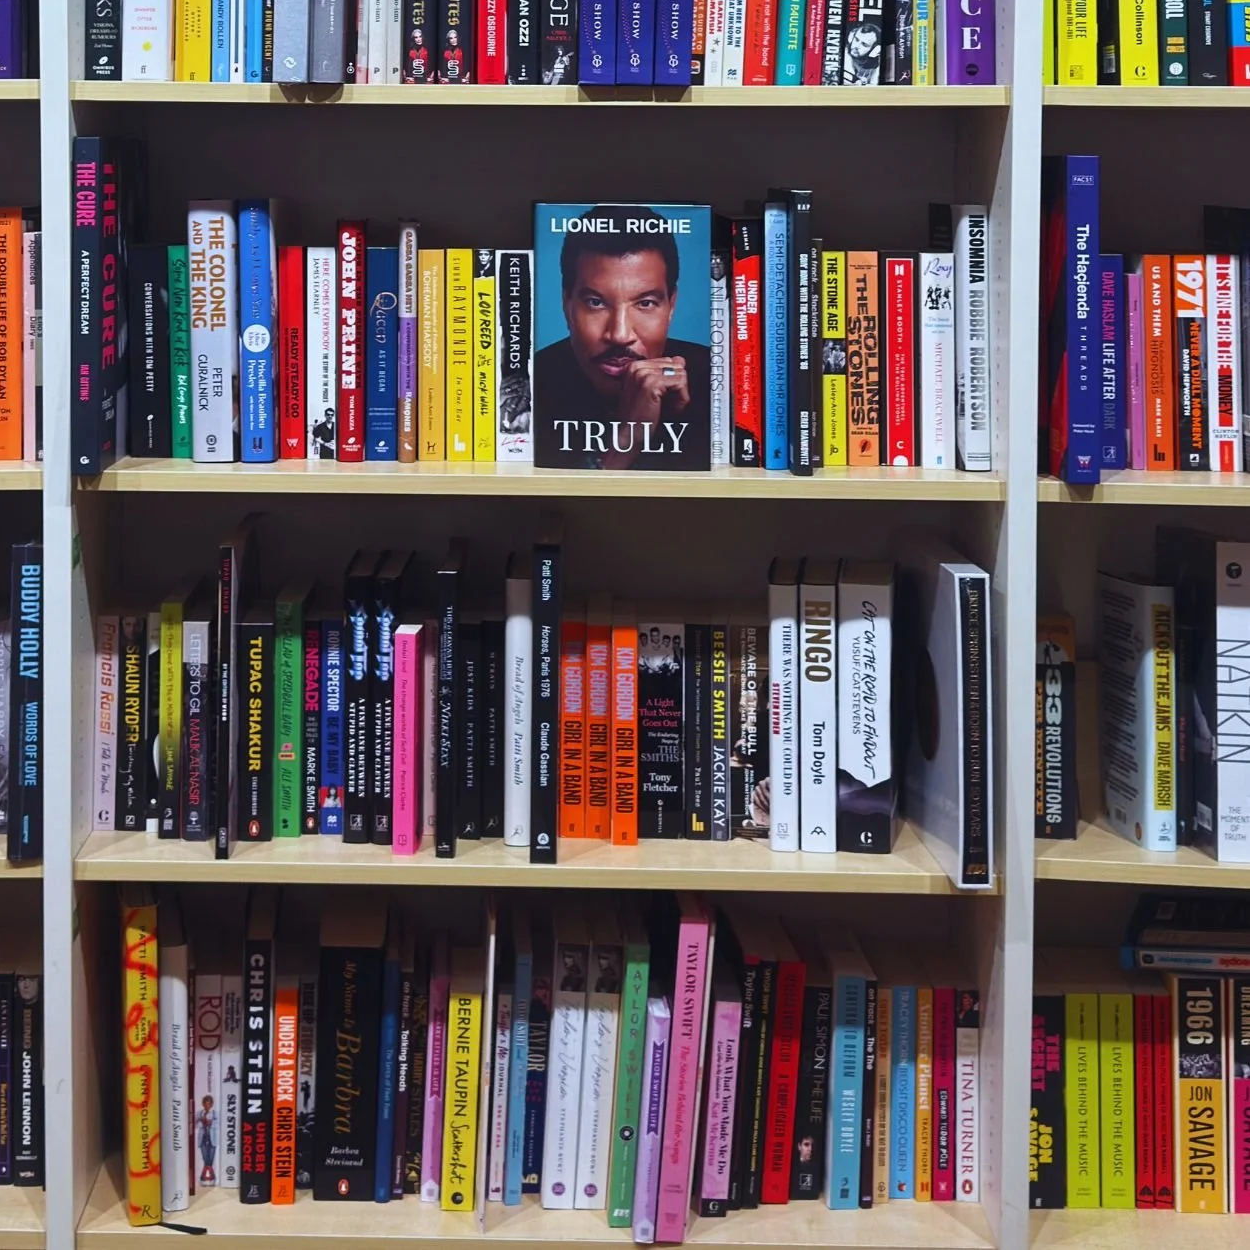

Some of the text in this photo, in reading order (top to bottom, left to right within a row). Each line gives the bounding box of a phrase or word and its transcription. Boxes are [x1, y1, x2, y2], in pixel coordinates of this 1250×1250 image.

[550, 218, 691, 233] LIONEL RICHIE
[969, 215, 984, 283] INSOMNIA
[341, 232, 357, 389] JOHN PRINE
[509, 258, 520, 369] KEITH RICHARDS
[1074, 225, 1089, 319] The Haçienda
[1176, 260, 1203, 317] 1971
[554, 420, 688, 453] TRULY
[19, 565, 39, 678] BUDDY HOLLY
[542, 560, 551, 600] Patti Smith
[248, 637, 262, 770] TUPAC SHAKUR
[713, 631, 725, 826] BESSIE SMITH JACKIE KAY
[812, 722, 825, 784] Tom Doyle
[1158, 742, 1170, 806] DAVE MARSH
[248, 954, 264, 1113] CHRIS STEIN
[454, 998, 471, 1116] BERNIE TAUPIN
[1186, 987, 1213, 1044] 1966
[22, 1052, 31, 1144] JOHN LENNON
[961, 1061, 974, 1174] TINA TURNER
[1189, 1107, 1215, 1191] SAVAGE
